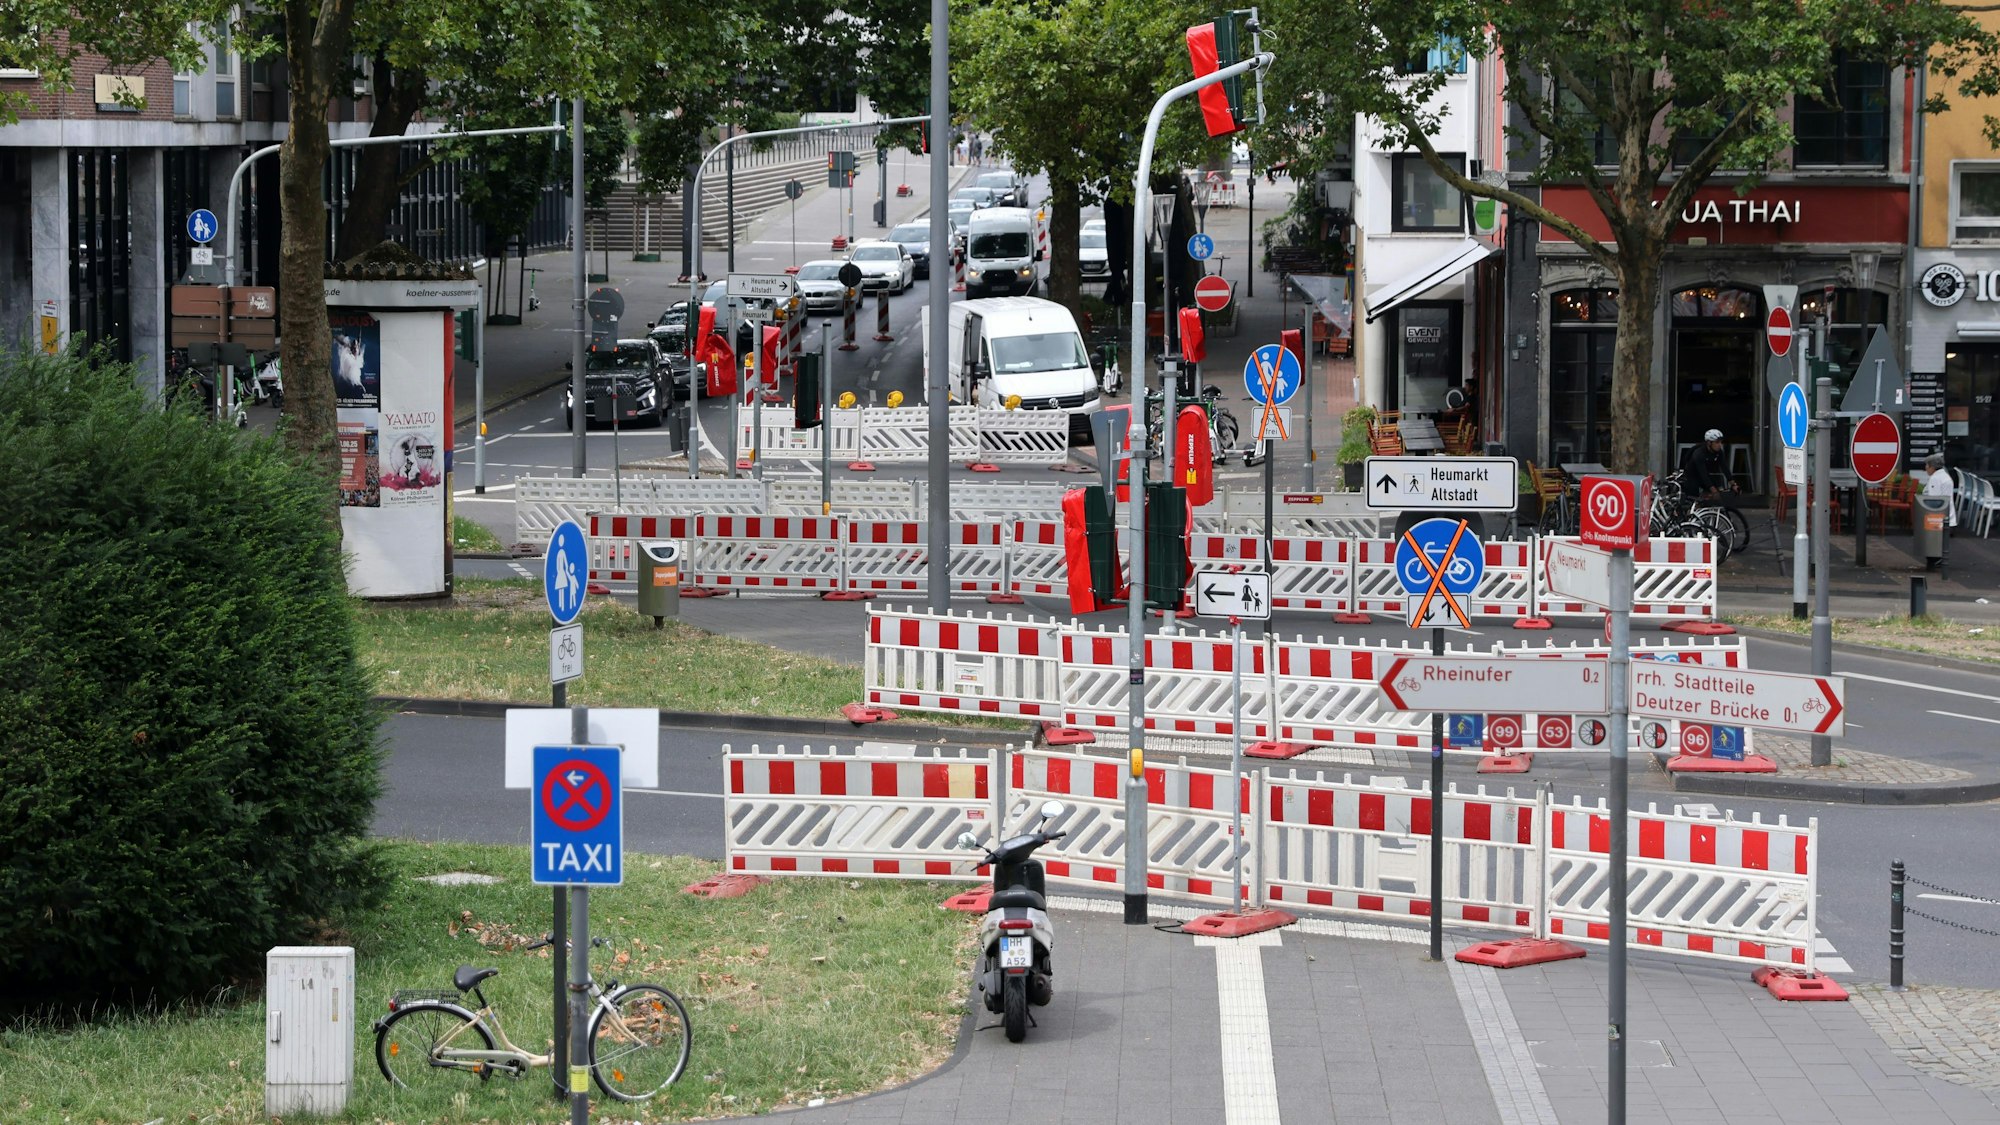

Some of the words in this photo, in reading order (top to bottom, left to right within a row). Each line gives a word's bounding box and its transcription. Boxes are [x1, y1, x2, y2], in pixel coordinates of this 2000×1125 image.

[1728, 199, 1800, 223] THAI
[1927, 268, 1938, 279] ICE
[1939, 266, 1961, 278] CREAM
[751, 277, 777, 285] Heumarkt
[751, 286, 772, 294] Altstadt
[1931, 296, 1957, 305] UNITED
[742, 310, 768, 319] Heumarkt
[1408, 328, 1440, 337] EVENT
[385, 411, 436, 425] YAMATO
[1431, 467, 1488, 481] Heumarkt
[1431, 488, 1478, 501] Altstadt
[1596, 493, 1619, 518] 90
[1594, 532, 1632, 546] Knotenpunkt
[1557, 550, 1586, 572] Neumarkt
[562, 662, 573, 674] frei
[1423, 665, 1513, 682] Rheinufer
[1636, 670, 1666, 687] rrh.
[1674, 672, 1755, 696] Stadtteile
[1636, 692, 1702, 713] Deutzer
[1710, 699, 1770, 721] Brücke
[1494, 726, 1514, 738] 99
[1545, 726, 1564, 738] 53
[1687, 732, 1704, 746] 96
[541, 842, 612, 872] TAXI
[1010, 938, 1022, 947] HH
[1007, 958, 1012, 966] A
[1014, 957, 1026, 966] 52
